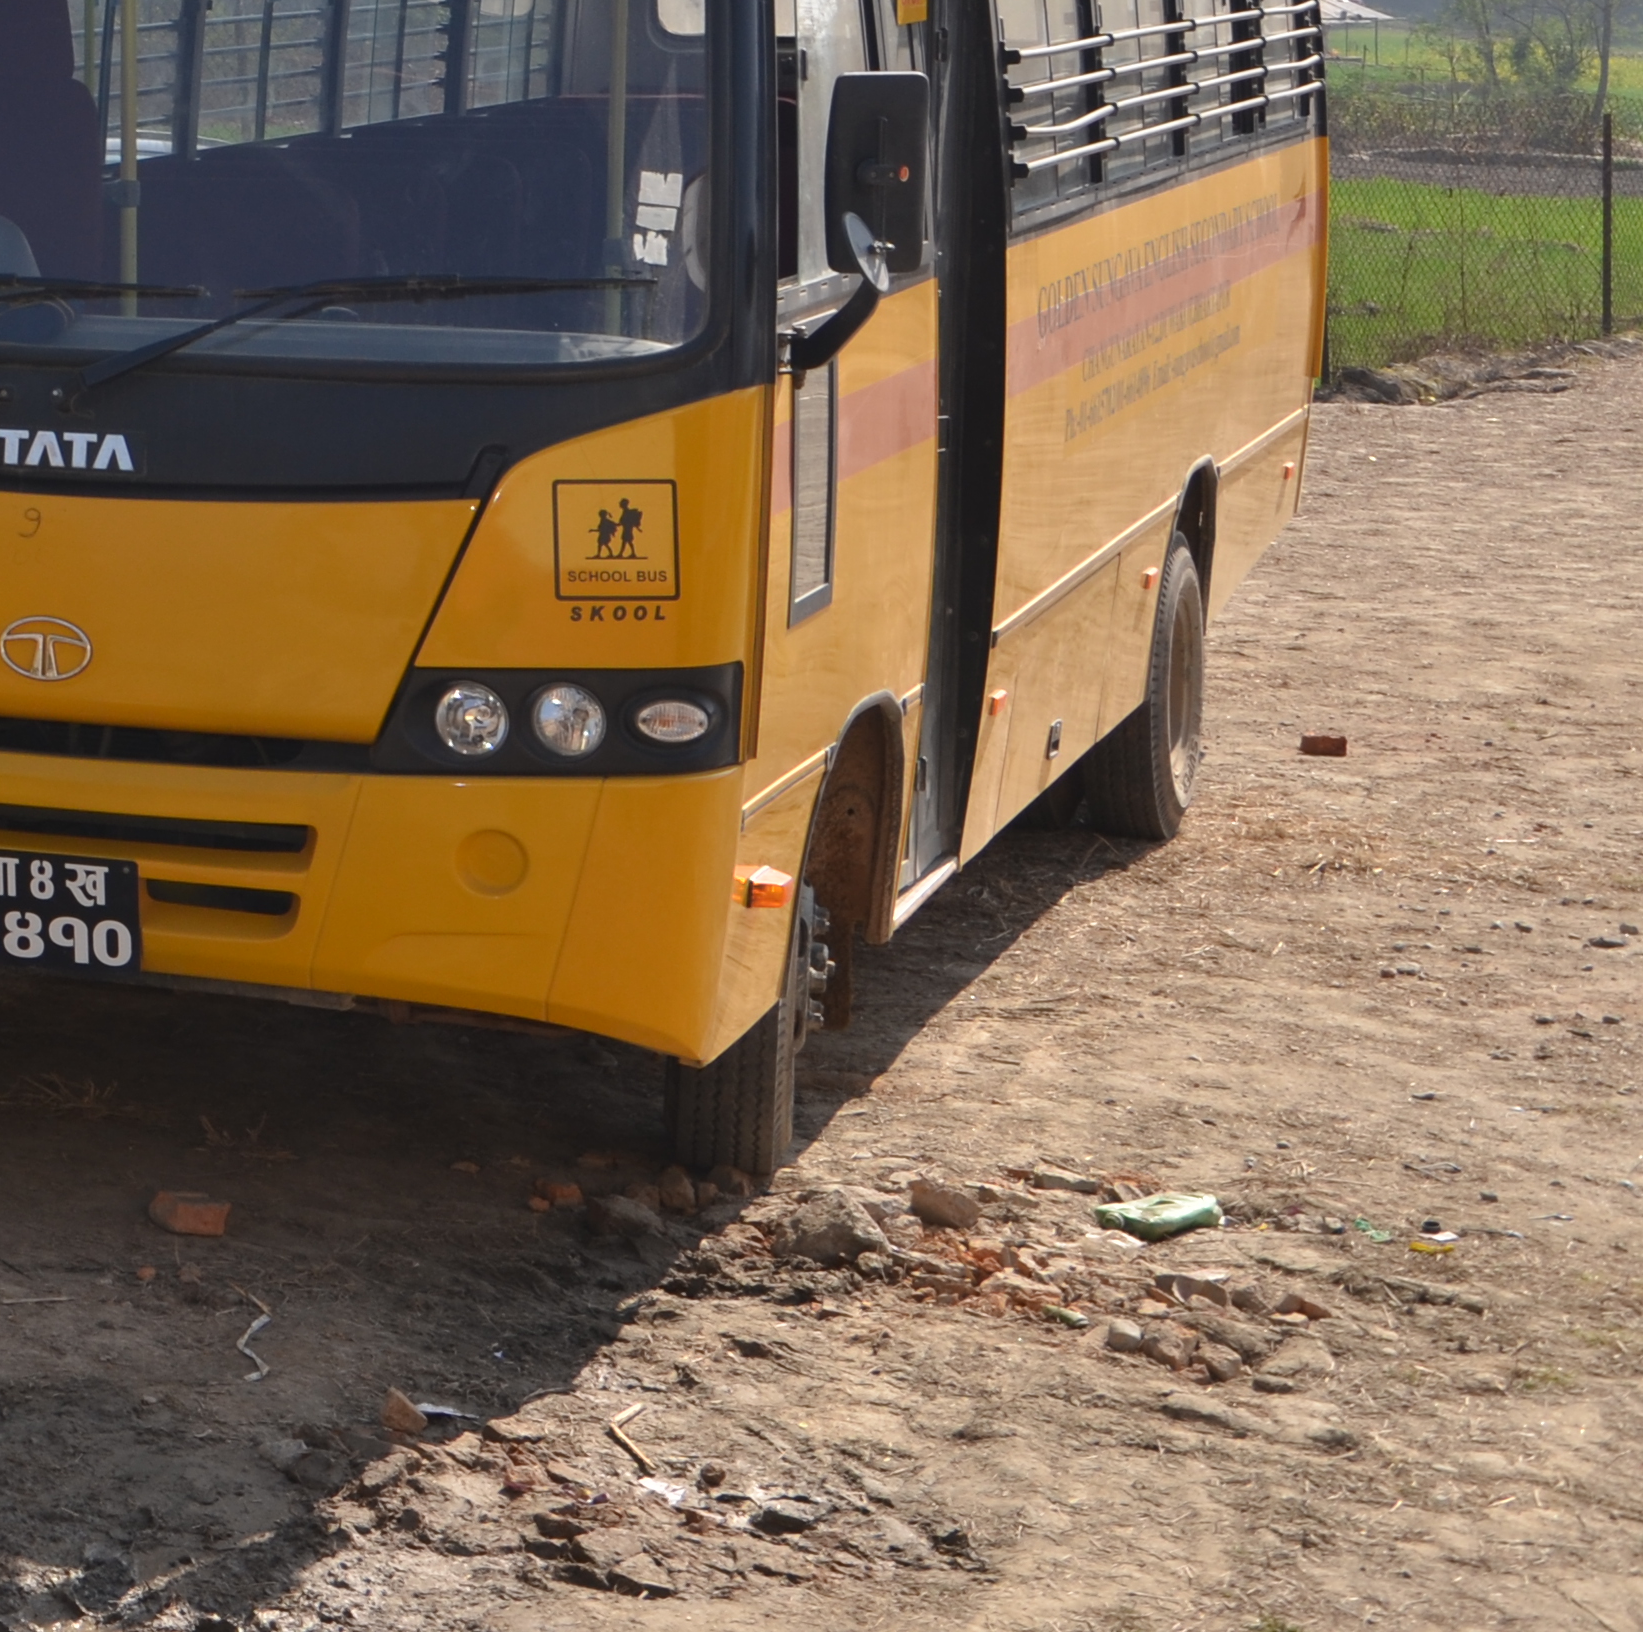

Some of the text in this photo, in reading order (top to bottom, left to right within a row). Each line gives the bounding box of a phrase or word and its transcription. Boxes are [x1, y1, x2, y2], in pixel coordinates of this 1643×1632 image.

[568, 570, 667, 583] SCHOOL BUS
[570, 605, 666, 622] SKOOL
